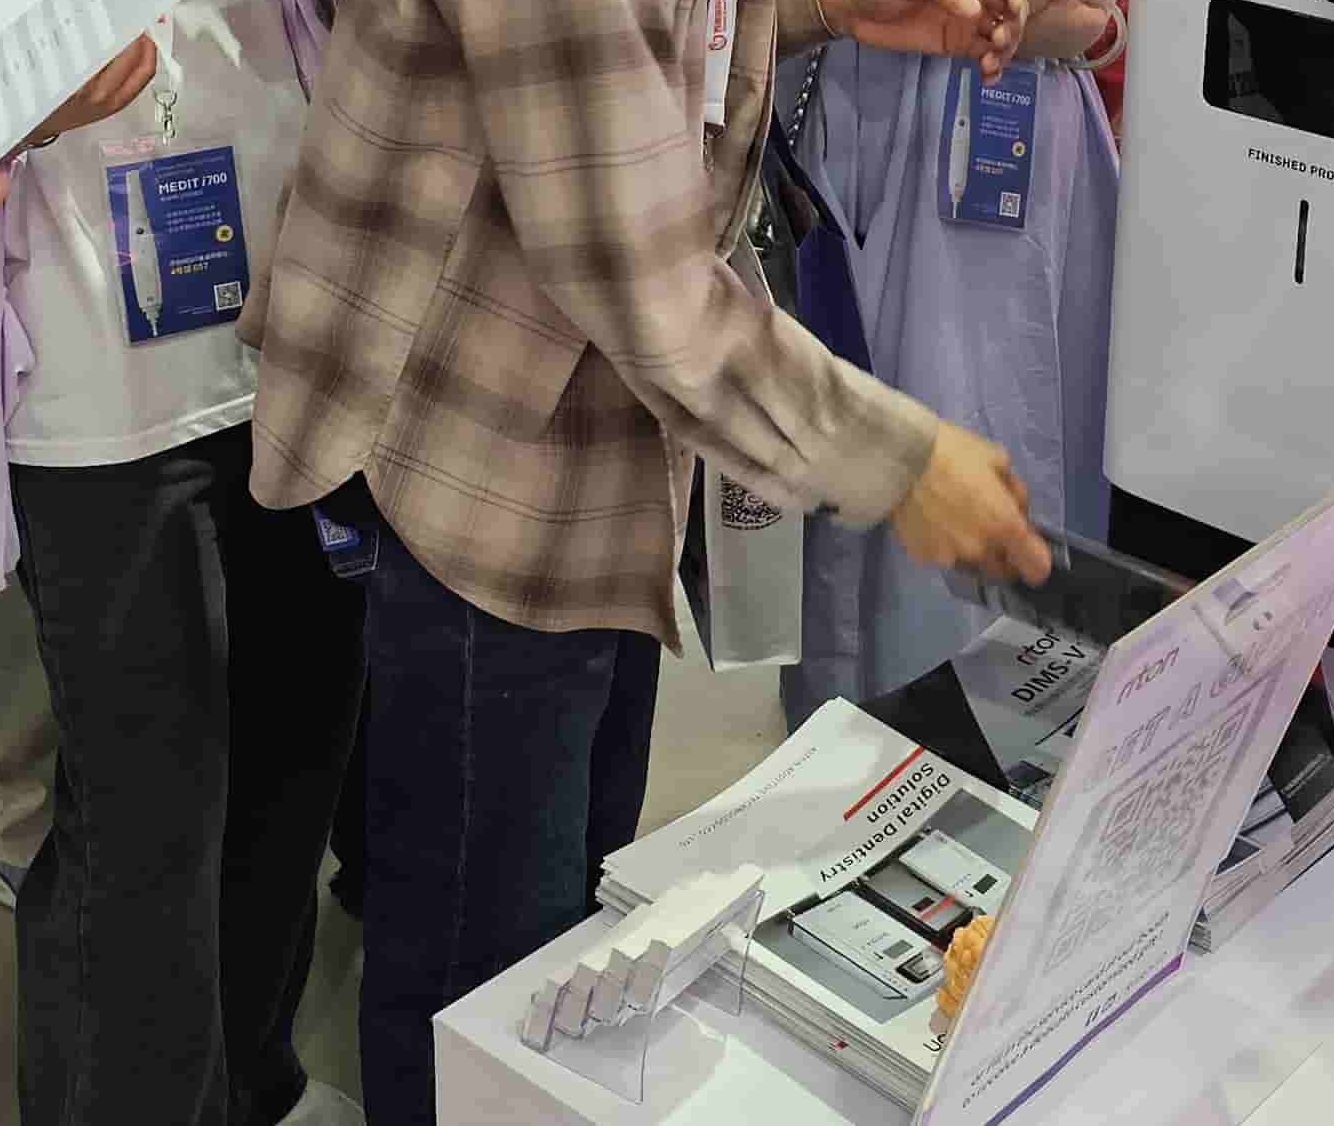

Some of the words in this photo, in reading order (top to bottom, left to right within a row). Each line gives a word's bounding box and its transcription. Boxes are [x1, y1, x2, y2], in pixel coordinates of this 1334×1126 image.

[158, 177, 201, 196] MEDIT
[201, 171, 228, 188] i700
[1247, 147, 1307, 173] FINISHED
[1010, 644, 1087, 703] DIMS-V
[866, 762, 935, 824] Solution
[896, 773, 951, 826] Digital
[819, 822, 898, 883] Dentistry
